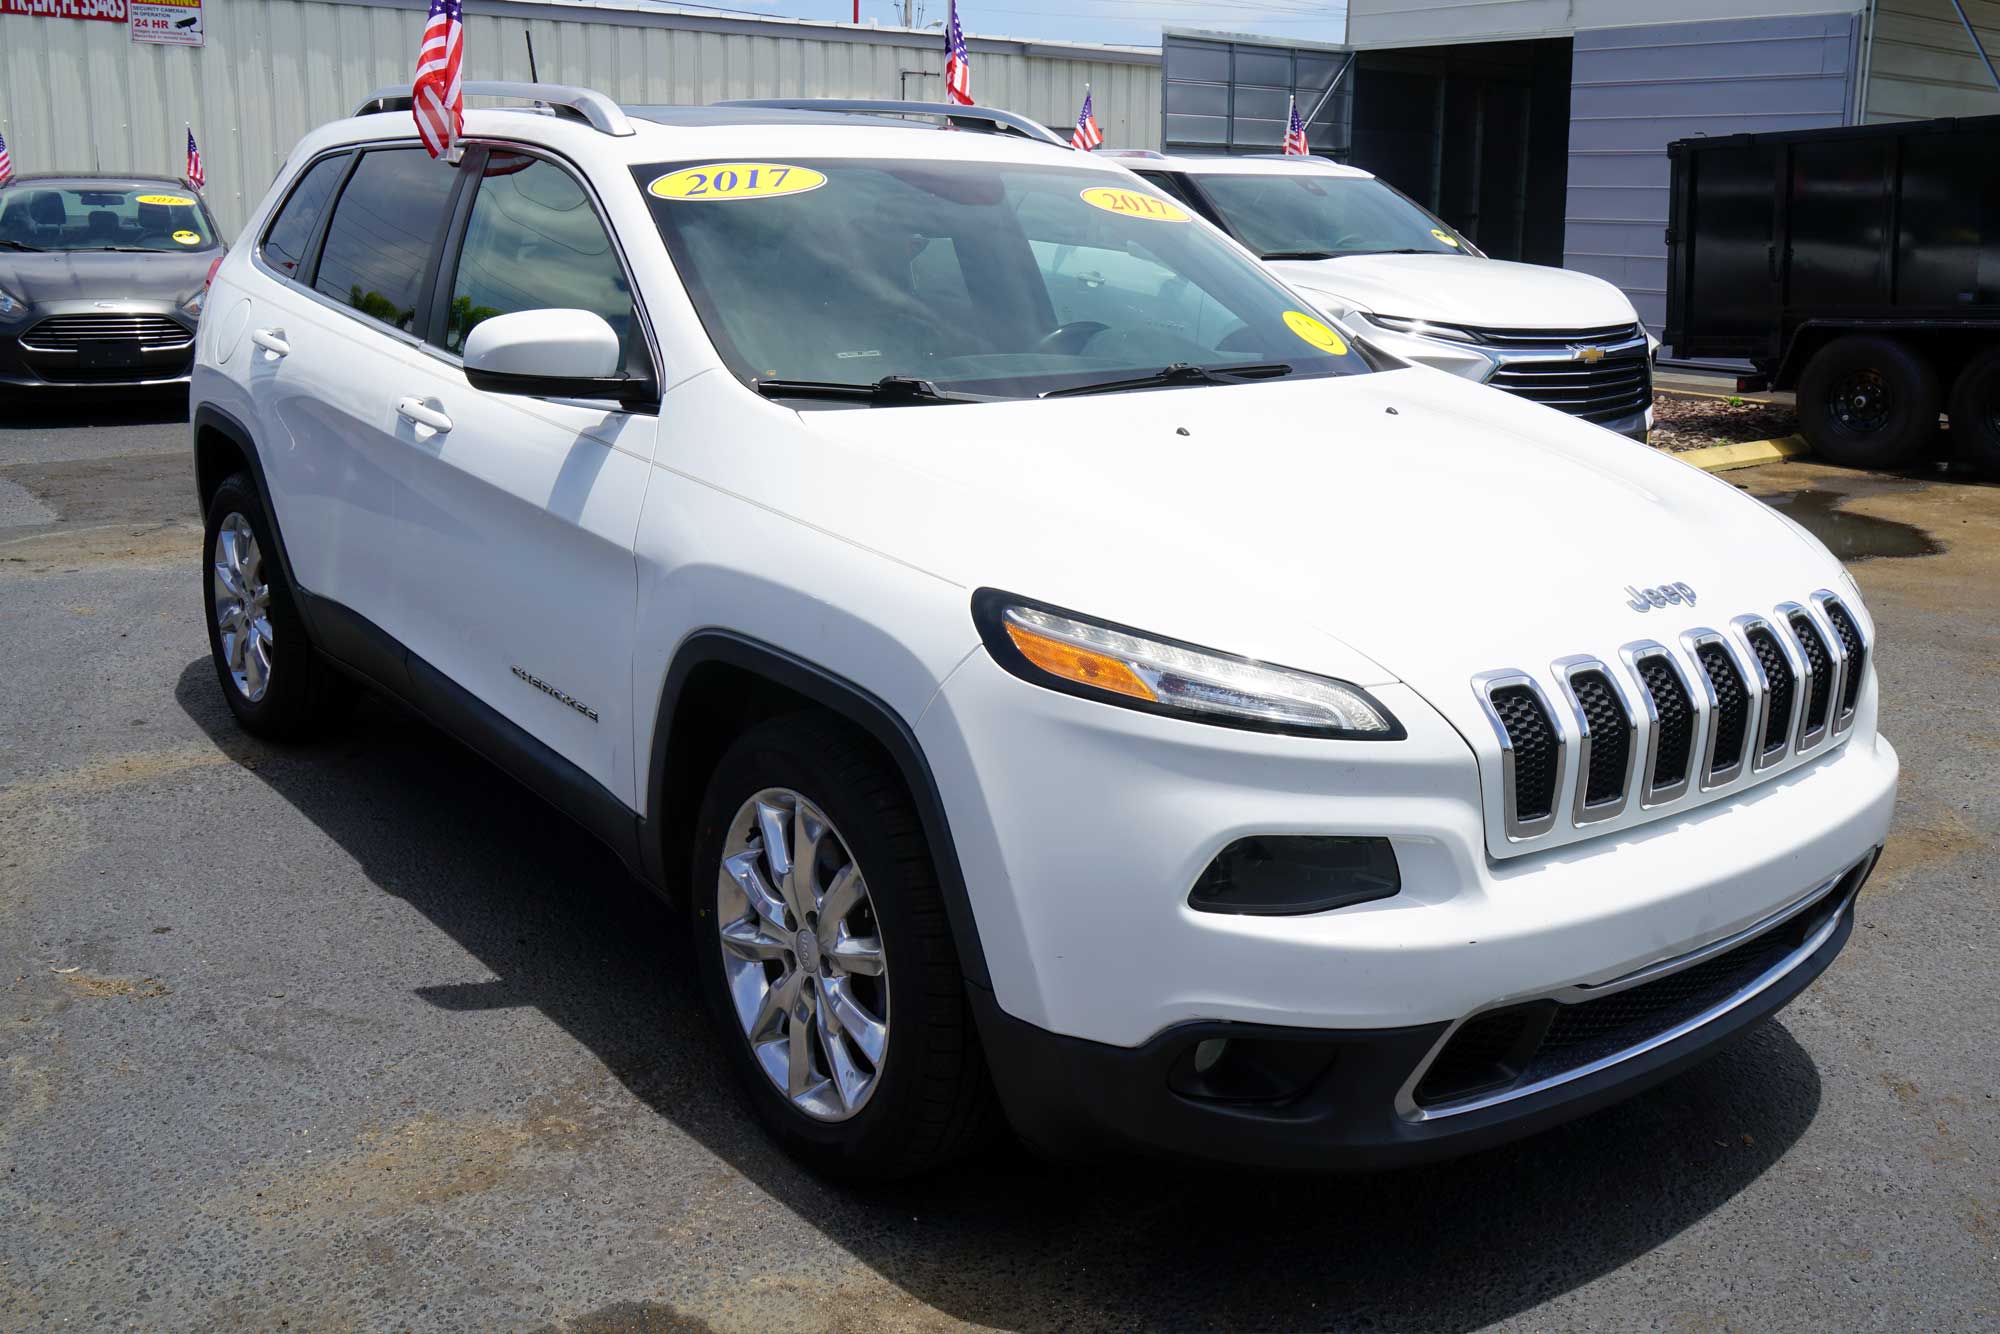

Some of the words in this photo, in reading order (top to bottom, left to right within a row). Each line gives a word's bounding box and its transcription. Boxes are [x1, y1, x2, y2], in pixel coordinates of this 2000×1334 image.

[134, 18, 148, 27] 24
[152, 19, 169, 29] HR
[685, 168, 790, 196] 2017
[1102, 193, 1167, 215] 2017
[1624, 582, 1697, 613] Jeep
